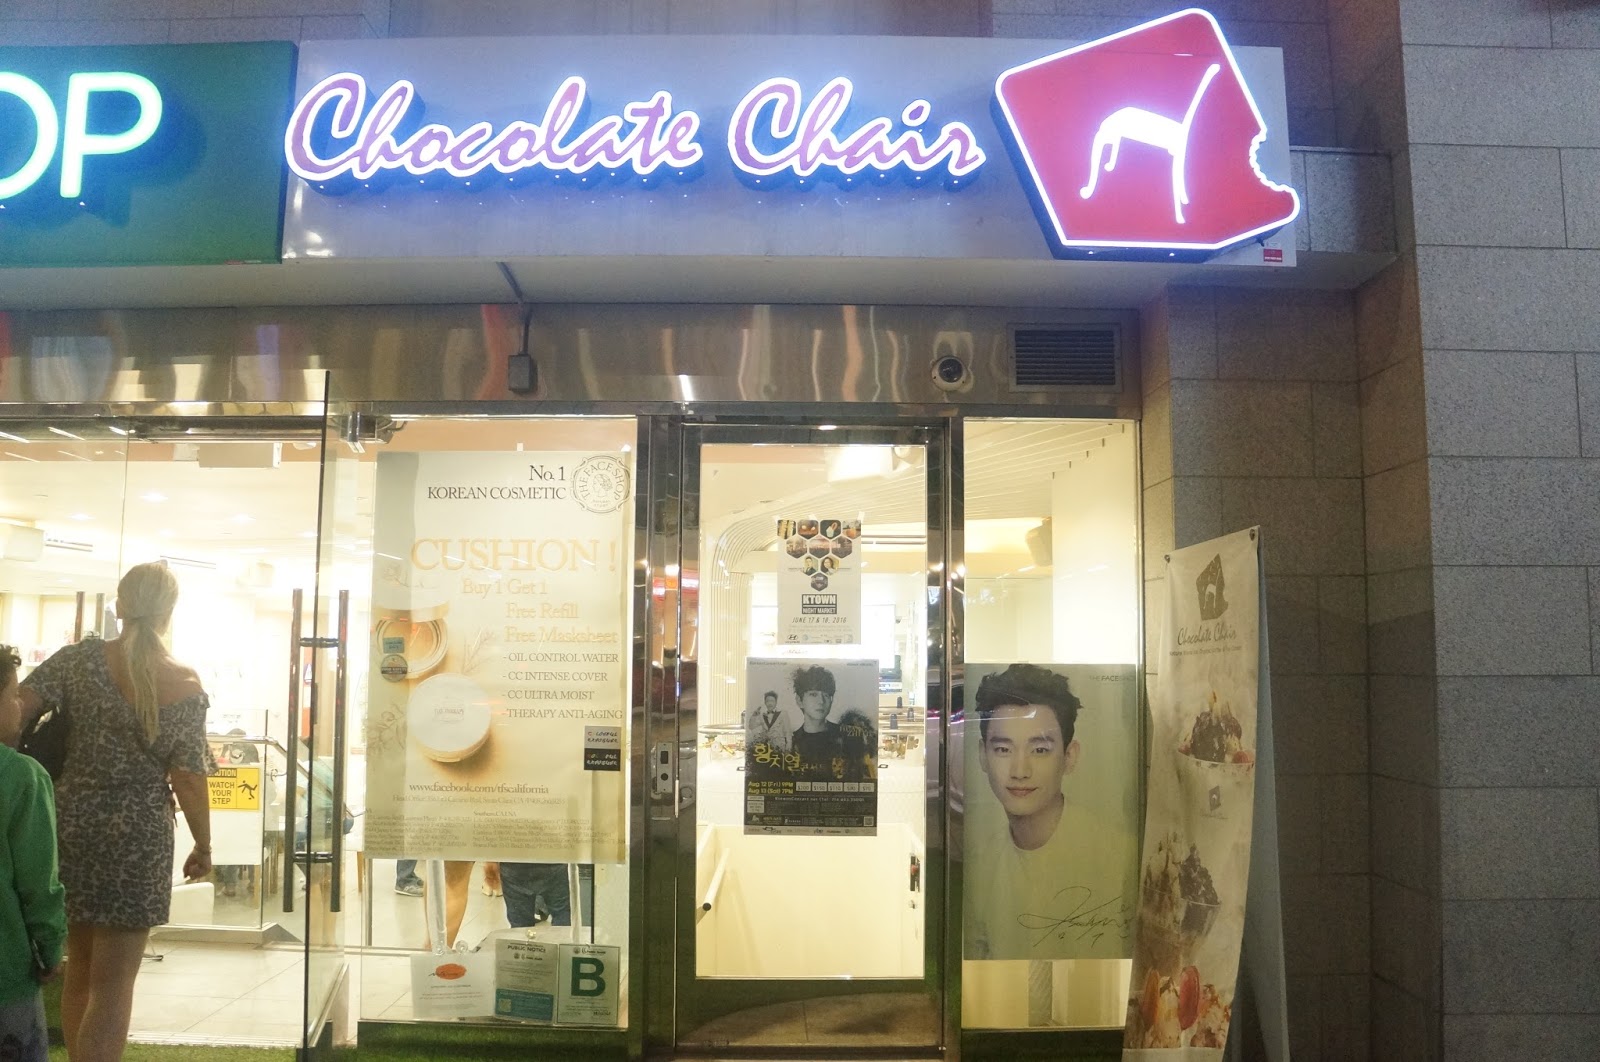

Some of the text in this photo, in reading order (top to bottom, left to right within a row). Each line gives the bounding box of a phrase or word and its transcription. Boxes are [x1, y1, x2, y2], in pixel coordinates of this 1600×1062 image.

[285, 73, 986, 181] Chocolate Chair
[579, 461, 625, 501] THE FACE SHOP
[428, 487, 566, 500] KOREAN COSMETIC
[411, 539, 600, 571] CUSHION
[462, 578, 548, 599] Buy 1 Get 1
[803, 595, 836, 604] KTOWN
[505, 602, 579, 618] Free Refill
[504, 626, 536, 642] Free
[1177, 621, 1236, 645] Chocolate Chair
[508, 653, 527, 661] OIL
[529, 653, 580, 662] CONTROL
[582, 653, 619, 662] WATER
[508, 671, 523, 680] CC
[525, 671, 570, 681] INTENSE
[572, 672, 608, 681] COVER
[508, 690, 523, 699] CC
[524, 690, 558, 699] ULTRA
[560, 690, 595, 700] MOIST
[558, 709, 623, 719] ANTI-AGING
[409, 782, 549, 794] www.facebook.com/tfscalifornia
[571, 956, 606, 997] B
